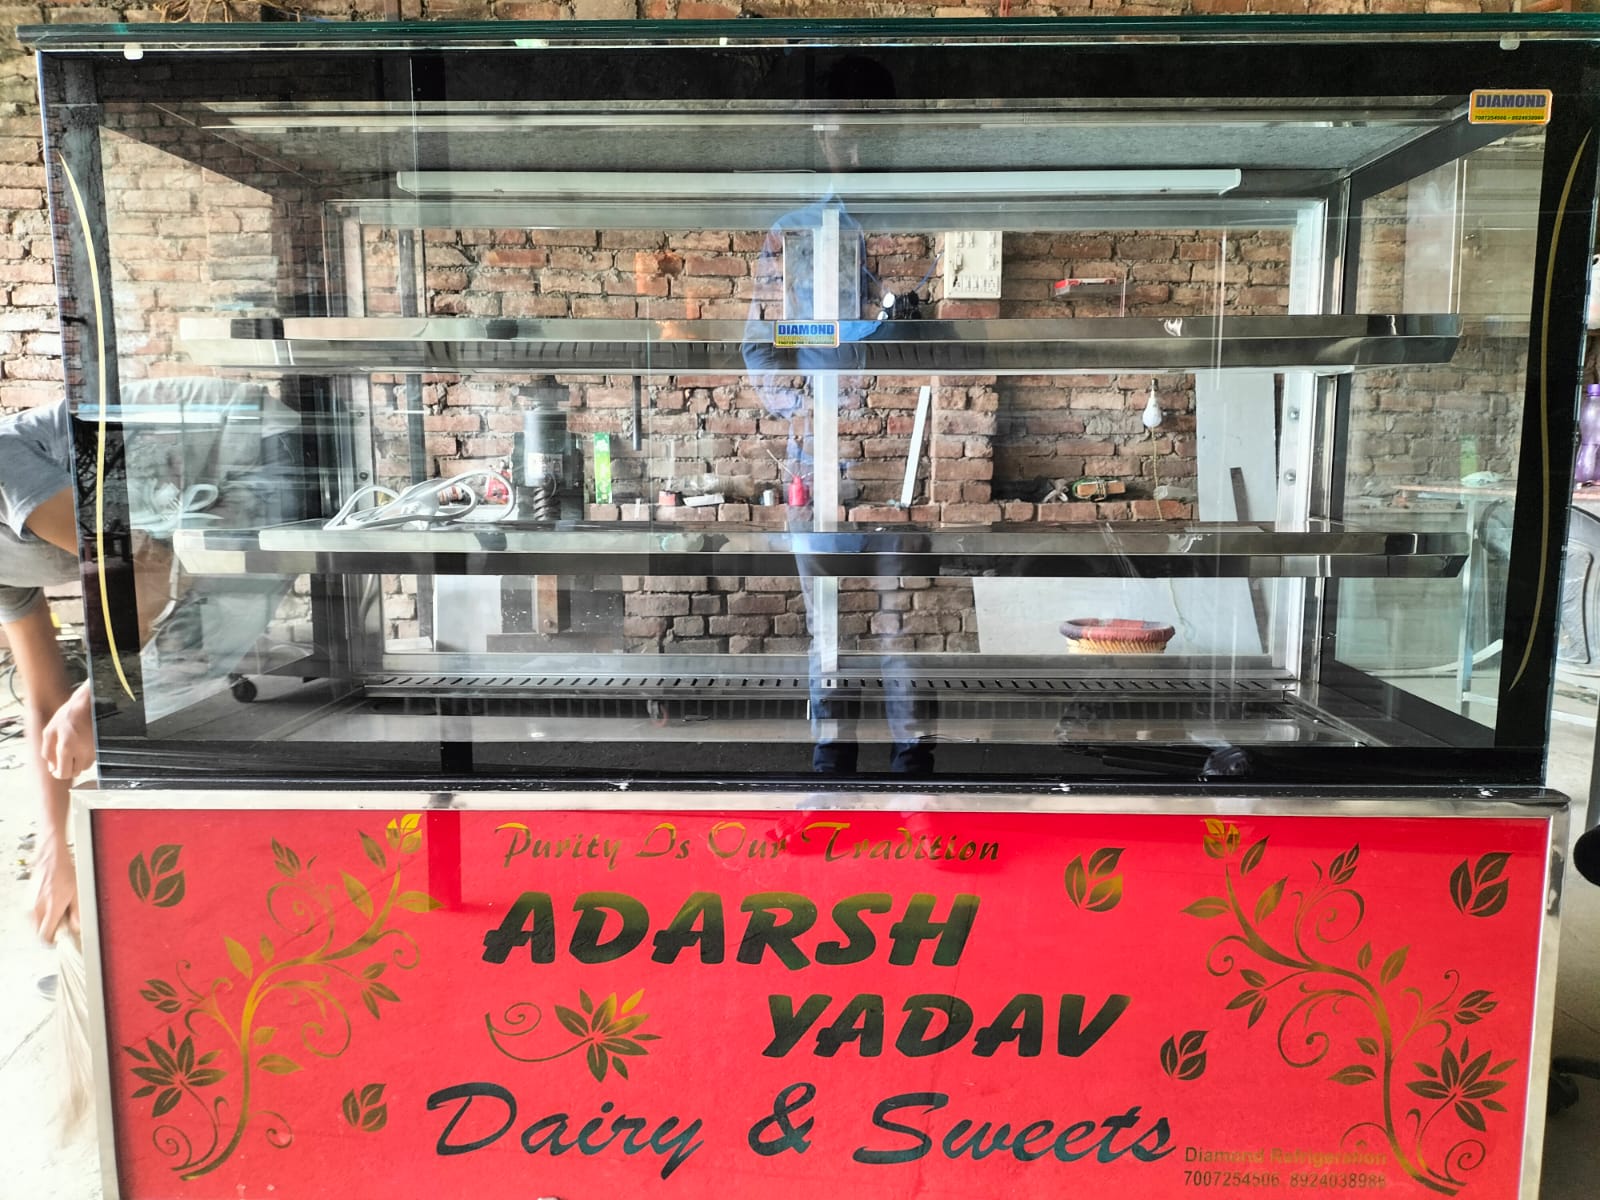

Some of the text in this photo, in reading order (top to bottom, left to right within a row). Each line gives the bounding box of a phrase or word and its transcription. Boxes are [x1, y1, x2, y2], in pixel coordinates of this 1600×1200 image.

[1476, 94, 1546, 108] DIAMOND
[778, 324, 835, 335] DIAMOND
[494, 821, 999, 871] Purity Is Our Tradition
[481, 891, 981, 970] ADARSH
[761, 993, 1131, 1058] YADAV
[426, 1081, 1178, 1180] Dairy & Sweets
[1185, 1146, 1387, 1169] Diamond Refrigeration
[1184, 1170, 1280, 1187] 7007254506
